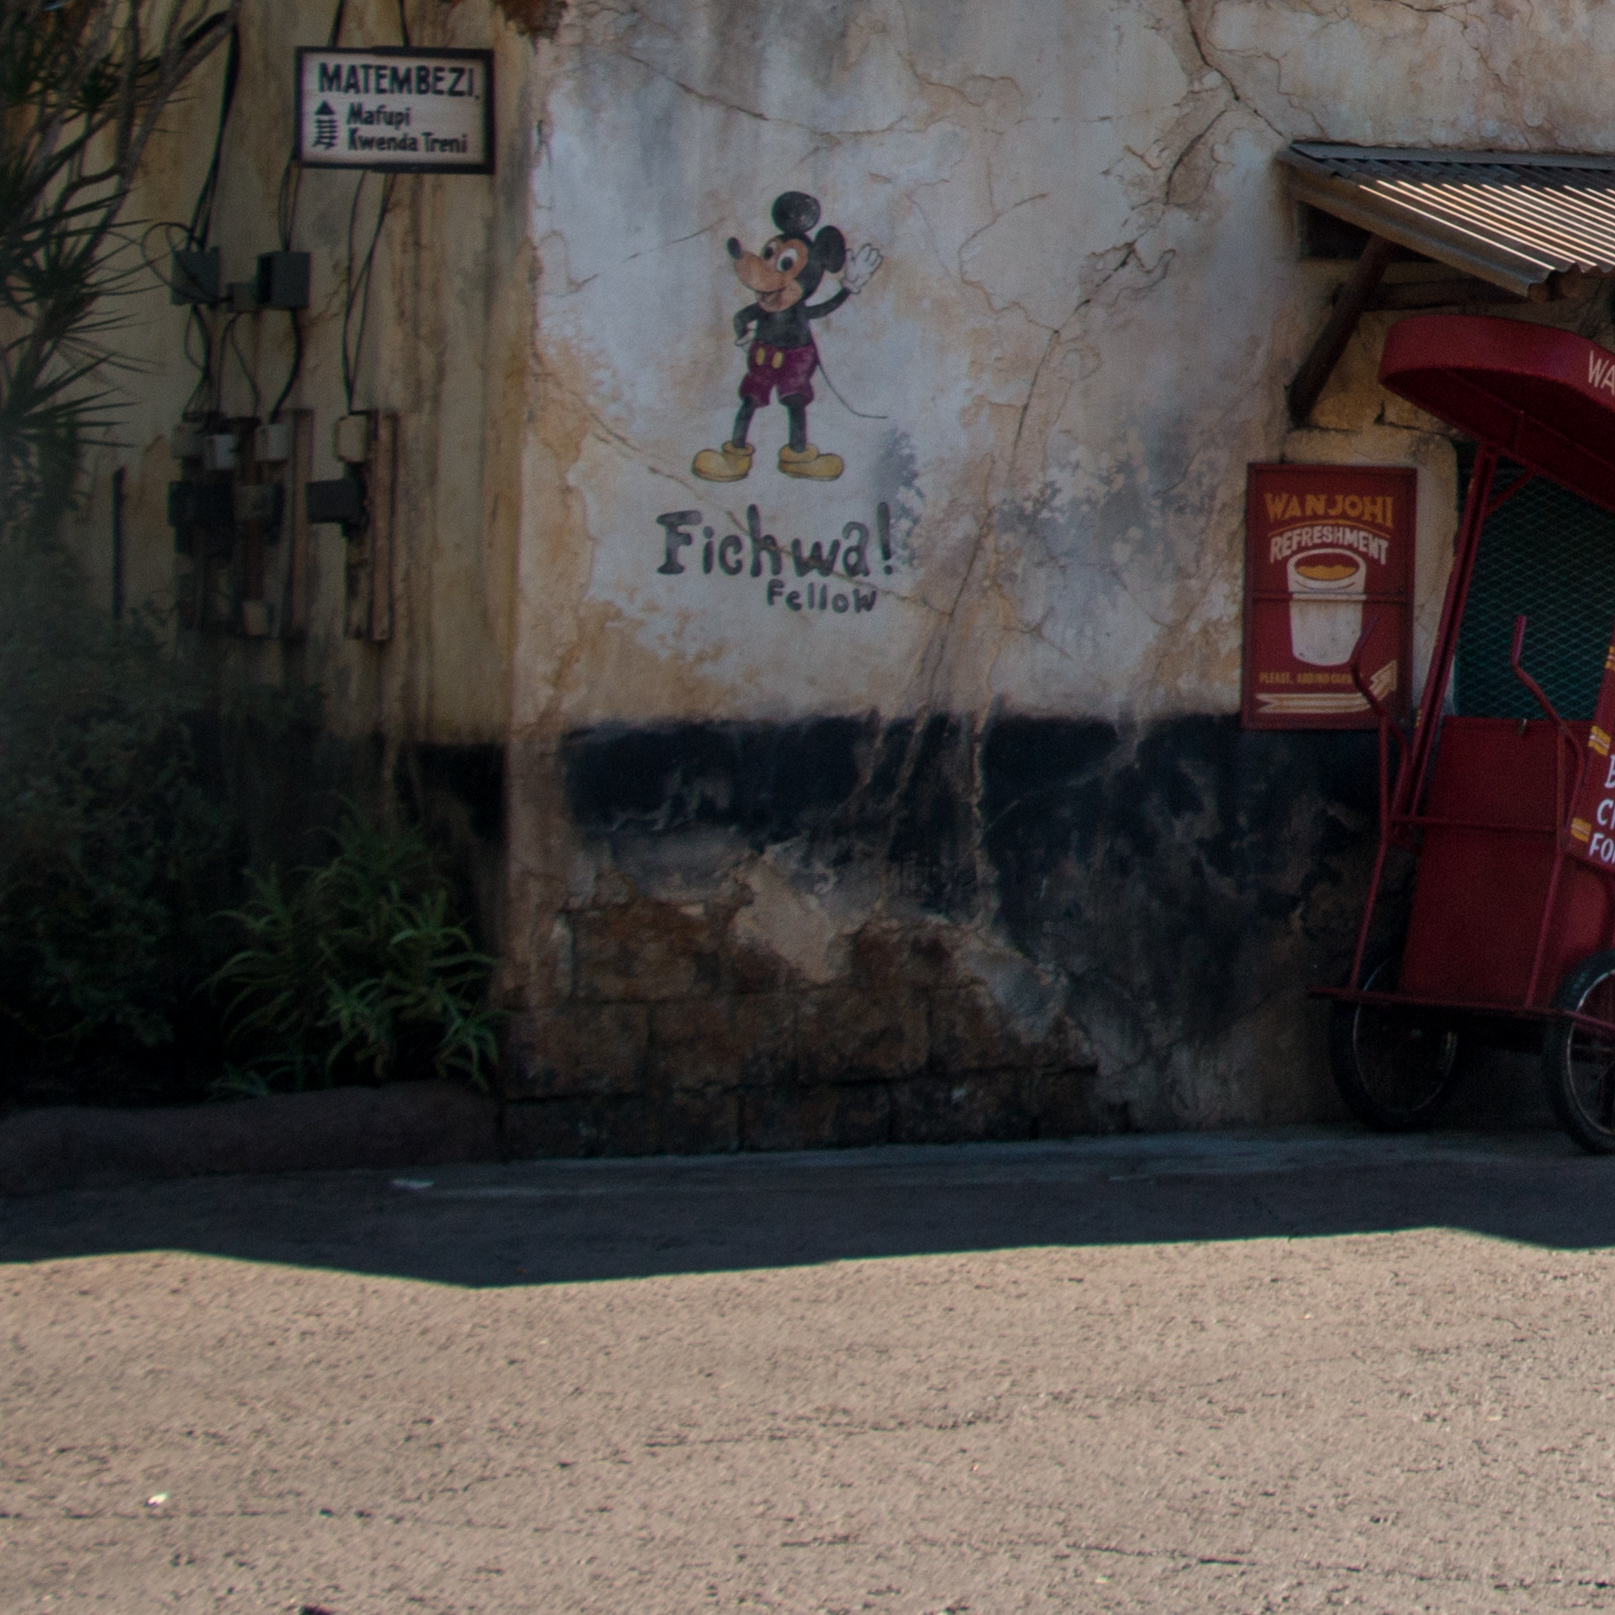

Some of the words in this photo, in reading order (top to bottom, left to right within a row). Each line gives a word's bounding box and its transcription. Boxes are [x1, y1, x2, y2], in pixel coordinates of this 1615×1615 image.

[347, 102, 412, 131] Mafupi
[348, 127, 418, 152] Kwenda
[421, 132, 468, 154] Treni
[1264, 492, 1395, 528] WANJOHI
[656, 501, 892, 577] Fichwa!
[1270, 525, 1389, 565] REFRESHMENT
[767, 578, 877, 613] Fellow
